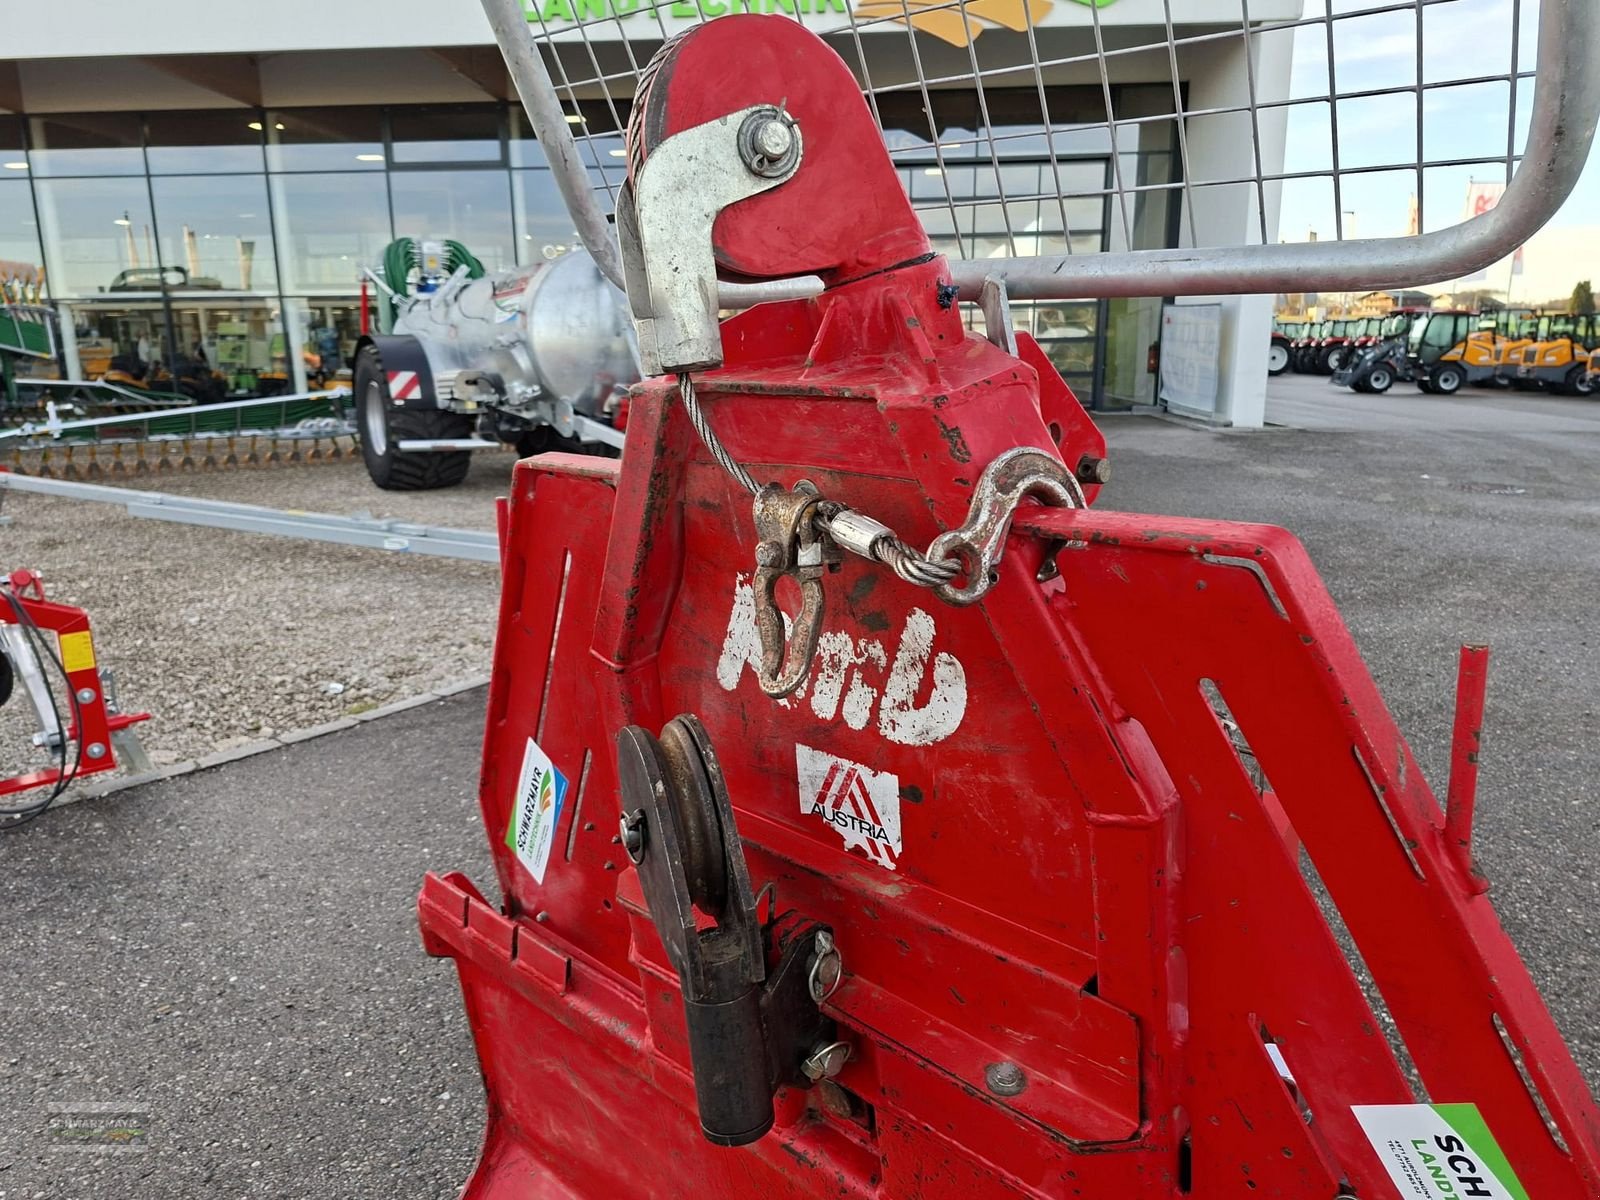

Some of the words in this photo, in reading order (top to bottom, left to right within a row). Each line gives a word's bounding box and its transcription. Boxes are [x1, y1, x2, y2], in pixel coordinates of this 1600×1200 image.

[517, 766, 543, 852] SCHWARZMAYR
[810, 802, 891, 844] AUSTRIA
[1403, 1156, 1434, 1200] AUROLZMÜNS
[1433, 1134, 1493, 1197] SCH
